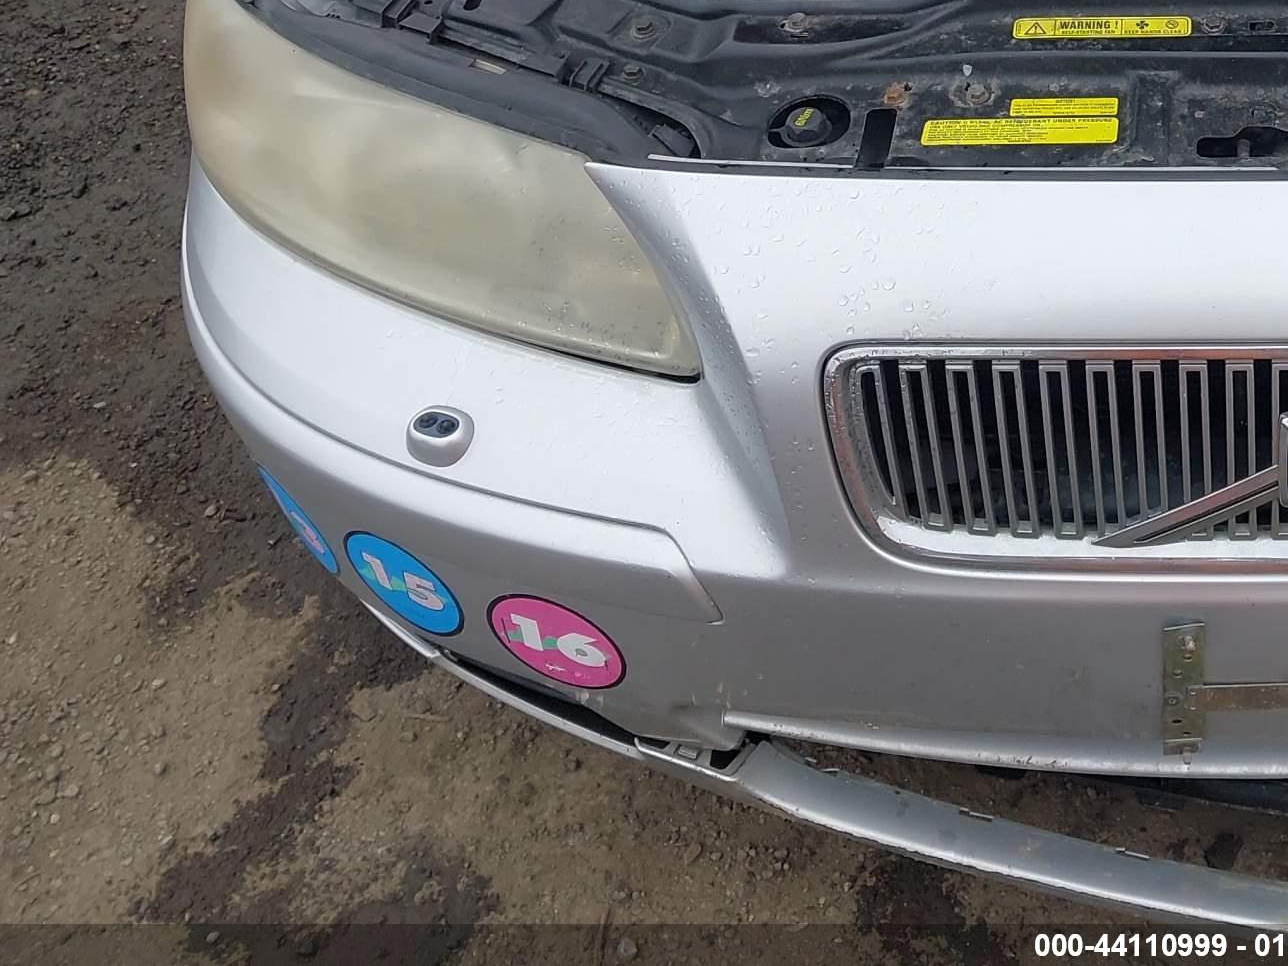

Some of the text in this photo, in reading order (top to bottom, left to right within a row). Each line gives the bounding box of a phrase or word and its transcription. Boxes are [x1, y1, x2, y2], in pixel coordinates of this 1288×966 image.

[1060, 20, 1111, 30] WARNING
[361, 551, 444, 611] 15
[510, 612, 608, 667] 16
